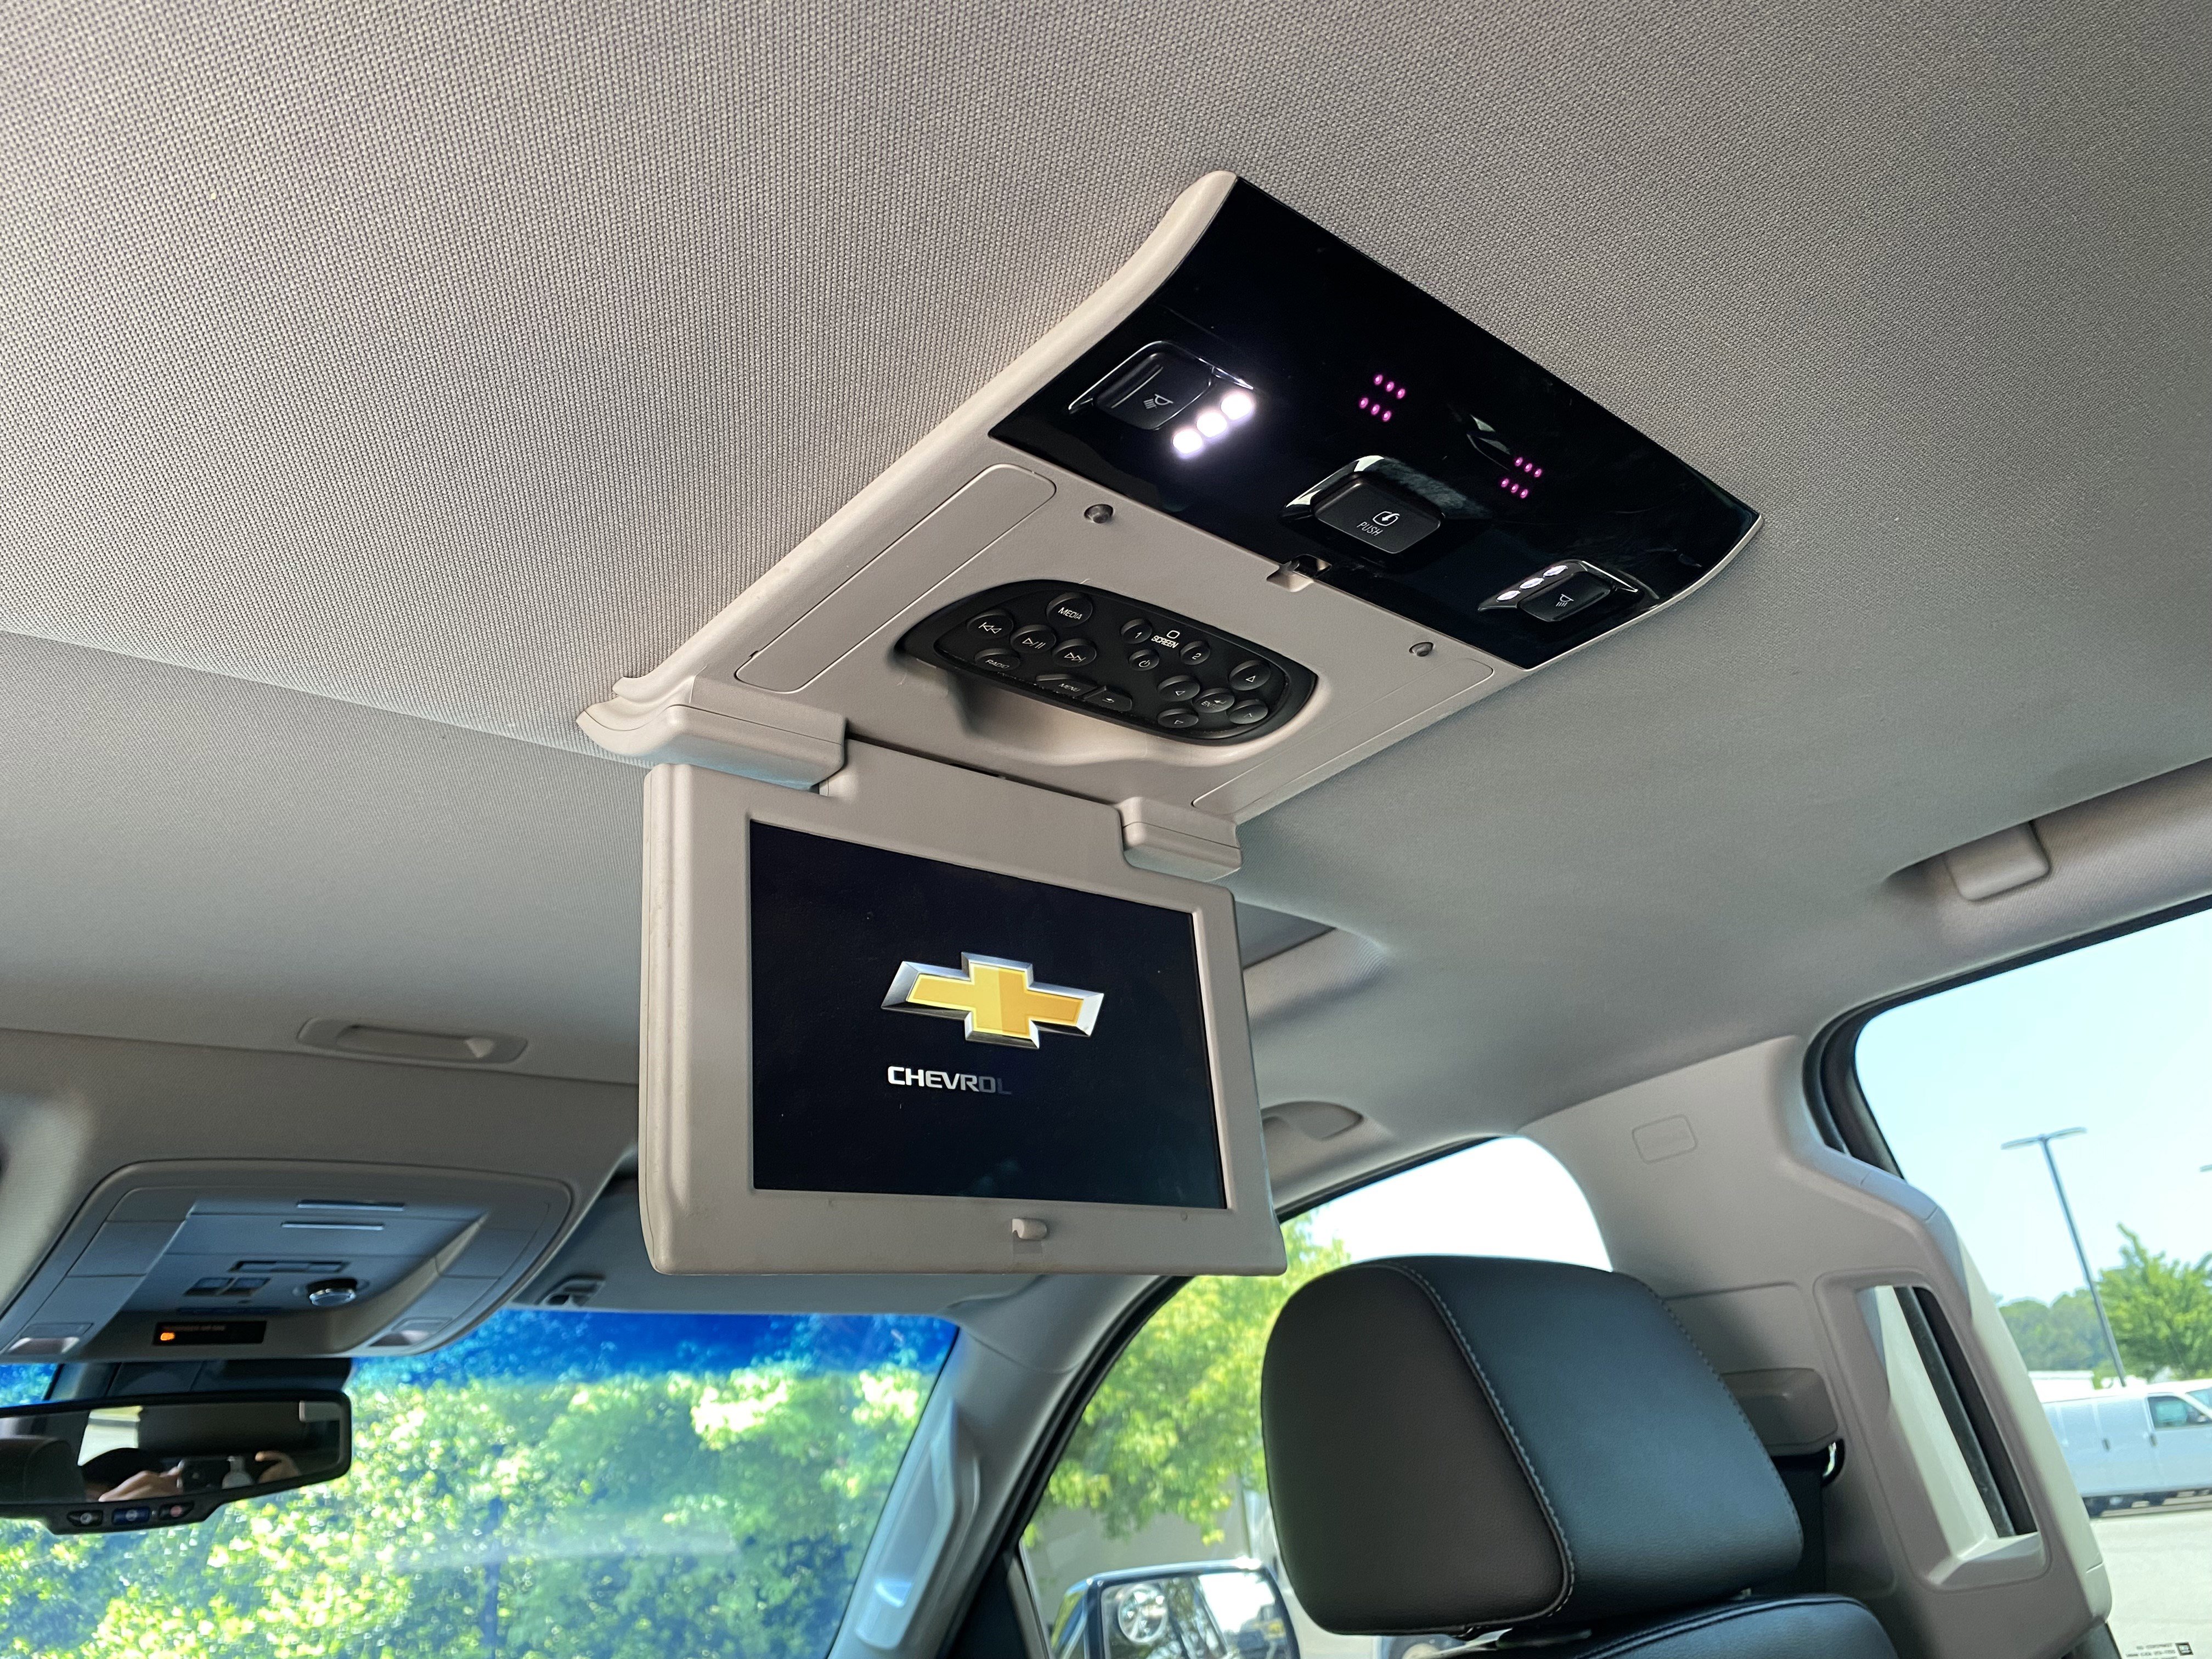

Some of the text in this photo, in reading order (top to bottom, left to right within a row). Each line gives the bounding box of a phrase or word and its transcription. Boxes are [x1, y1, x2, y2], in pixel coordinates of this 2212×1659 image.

[1357, 521, 1383, 537] PUSH
[1058, 607, 1082, 620] MEDIA
[1151, 635, 1179, 648] SCREEN
[985, 659, 1009, 669] RADIO
[1058, 683, 1081, 692] MENU
[887, 1065, 1012, 1095] CHEVROL
